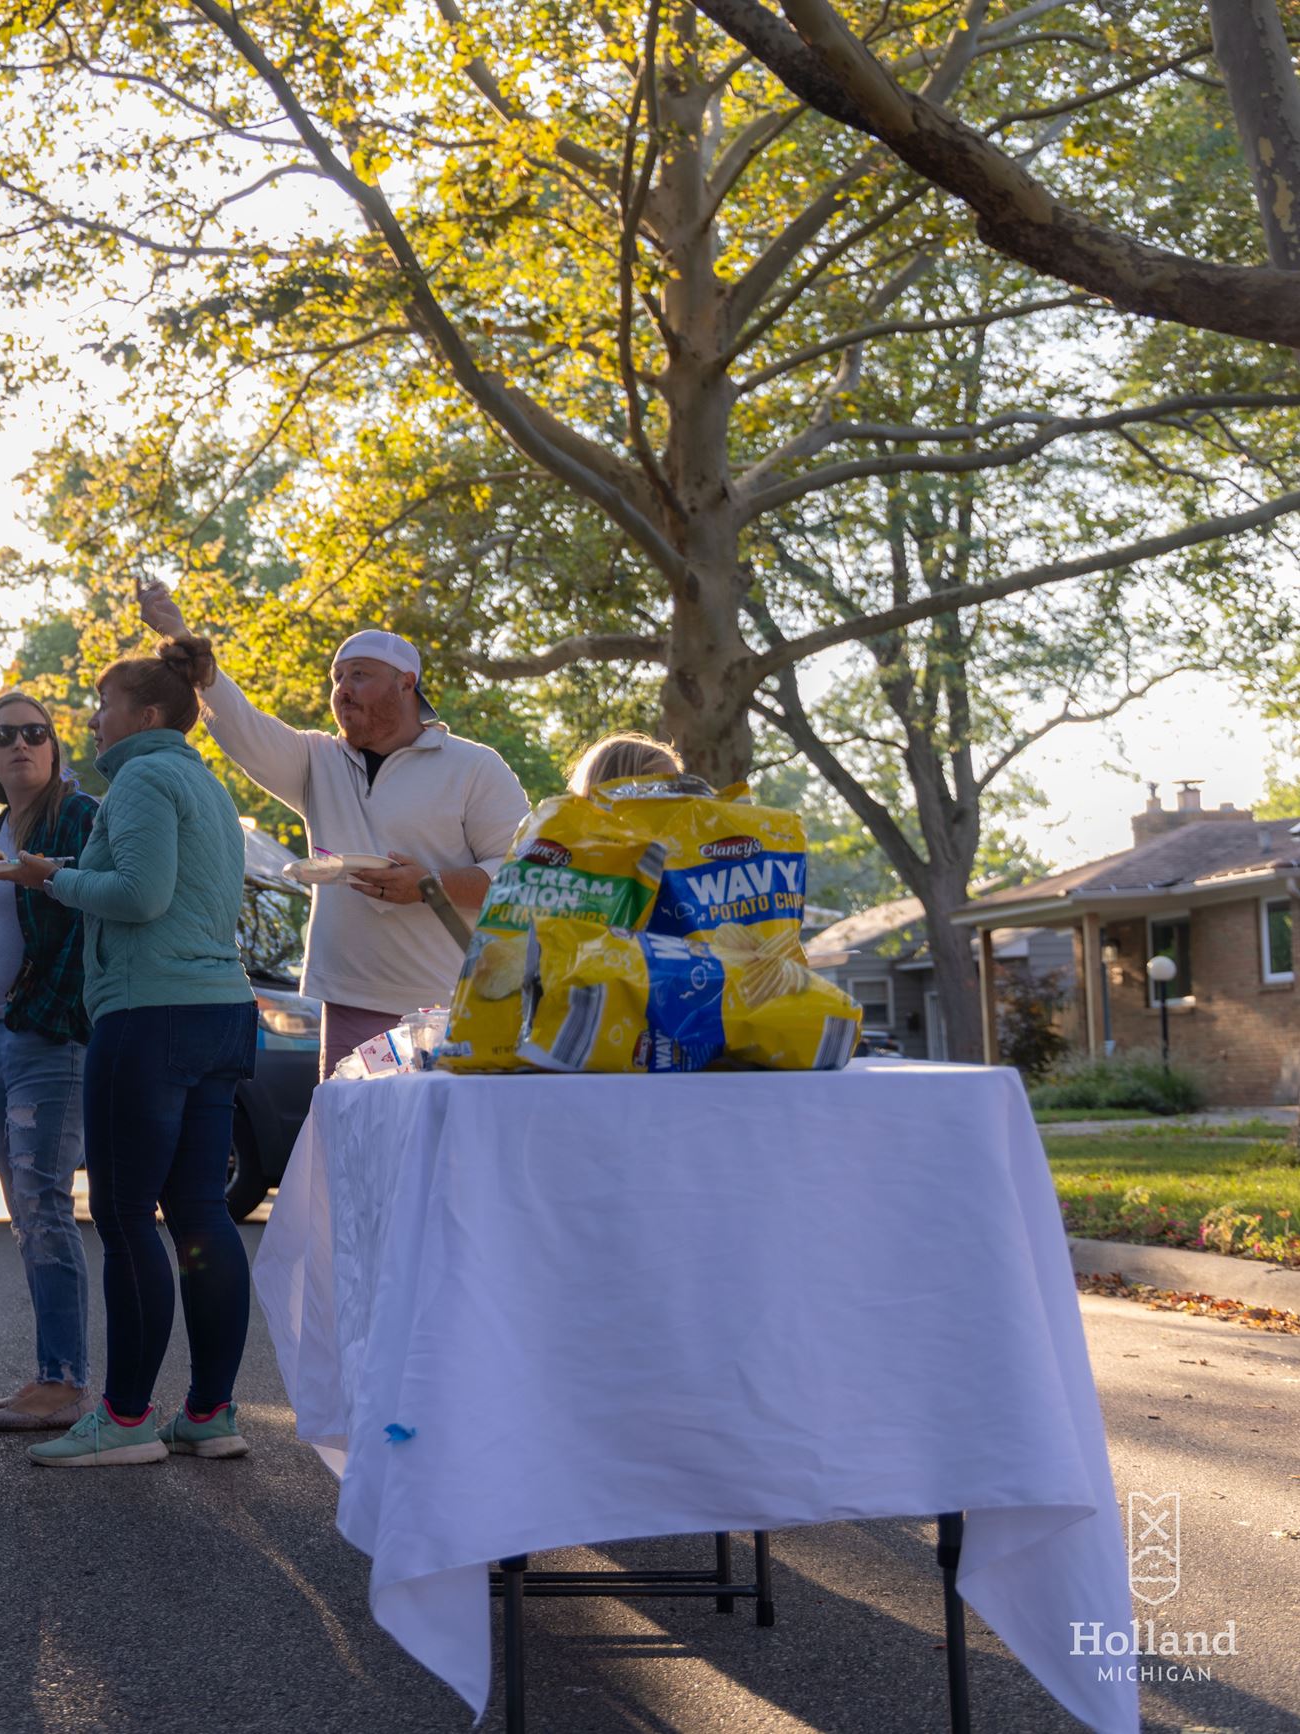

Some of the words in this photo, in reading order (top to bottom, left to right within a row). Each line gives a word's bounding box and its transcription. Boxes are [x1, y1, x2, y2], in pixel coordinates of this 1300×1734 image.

[700, 839, 762, 859] Clancy's
[491, 883, 581, 909] ONION
[525, 866, 614, 897] CREAM
[686, 859, 798, 906] WAVY
[709, 895, 769, 921] POTATO
[774, 892, 805, 910] CHIP
[655, 1029, 672, 1069] WAV
